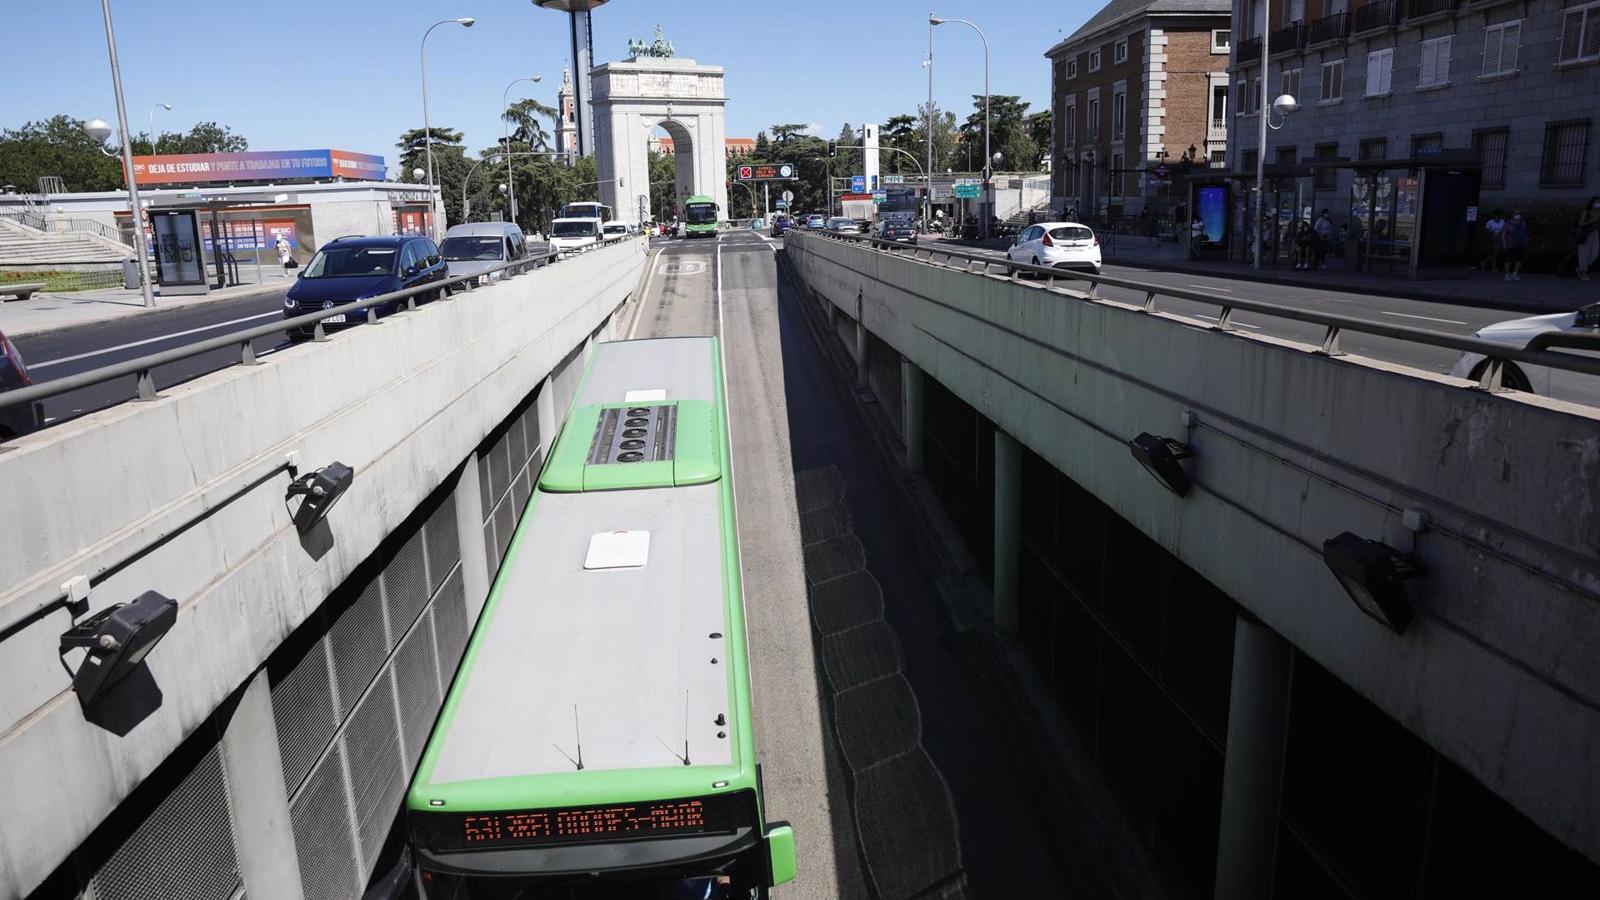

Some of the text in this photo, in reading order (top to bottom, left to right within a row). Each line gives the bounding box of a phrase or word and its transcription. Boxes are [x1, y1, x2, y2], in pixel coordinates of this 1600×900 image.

[148, 164, 166, 174] DEJA
[167, 163, 175, 173] DE
[176, 161, 210, 173] ESTUDIAR
